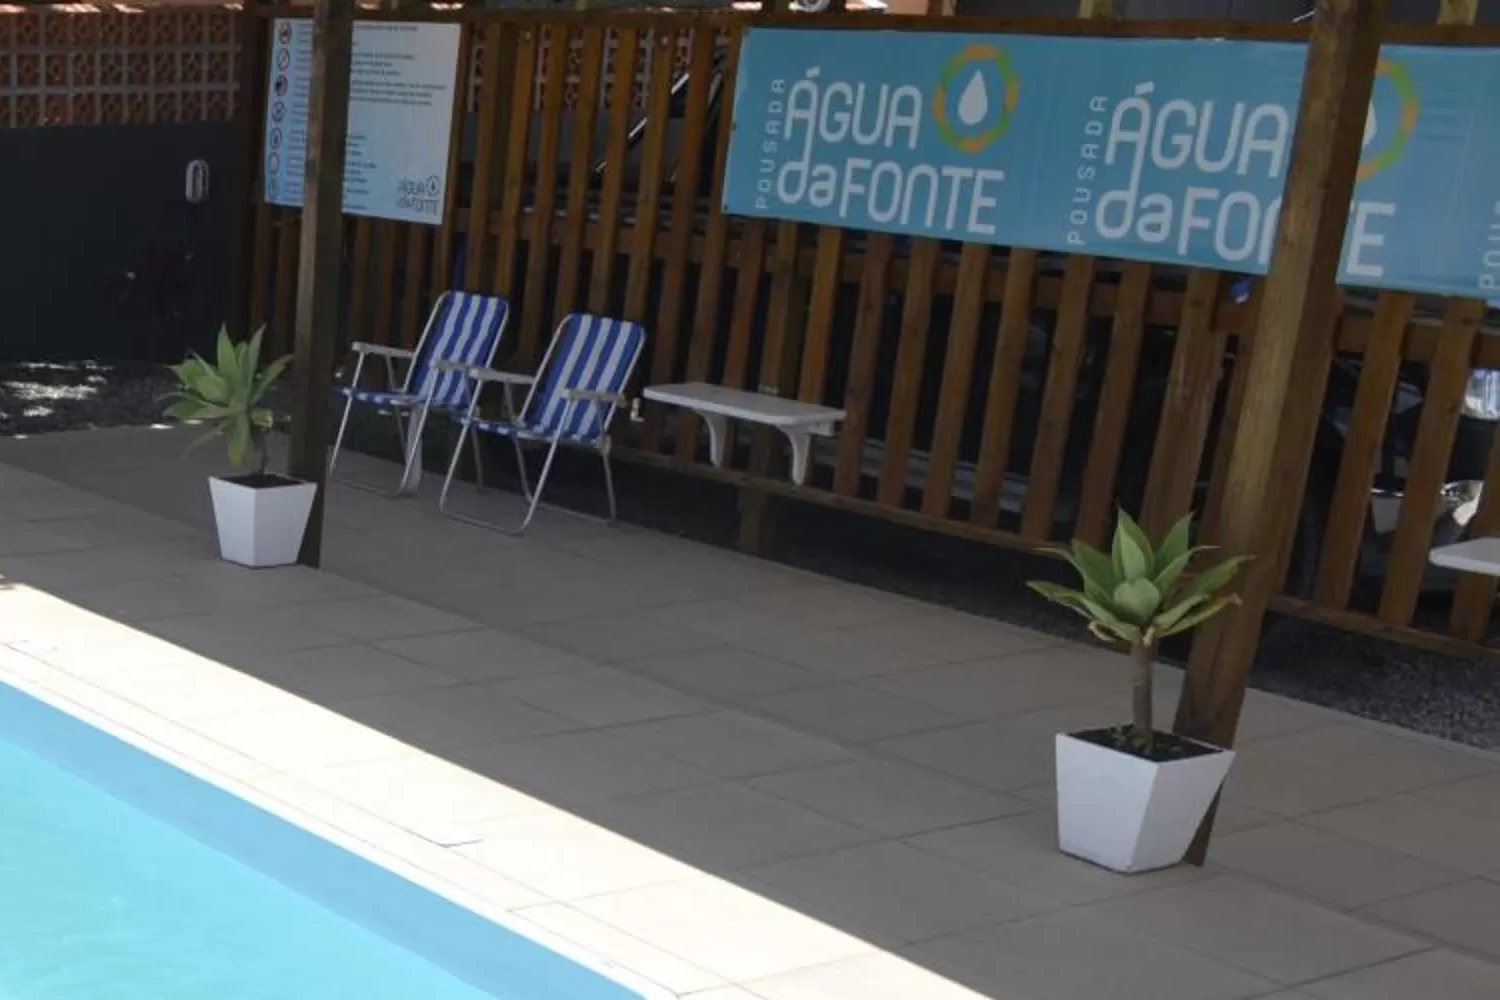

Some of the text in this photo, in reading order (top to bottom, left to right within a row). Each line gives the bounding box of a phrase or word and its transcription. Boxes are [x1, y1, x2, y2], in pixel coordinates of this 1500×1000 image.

[755, 79, 785, 209] POUSADA
[783, 66, 923, 150] ÁGUA
[1104, 81, 1289, 179] ÁGUA
[1067, 96, 1108, 246] POUSADA
